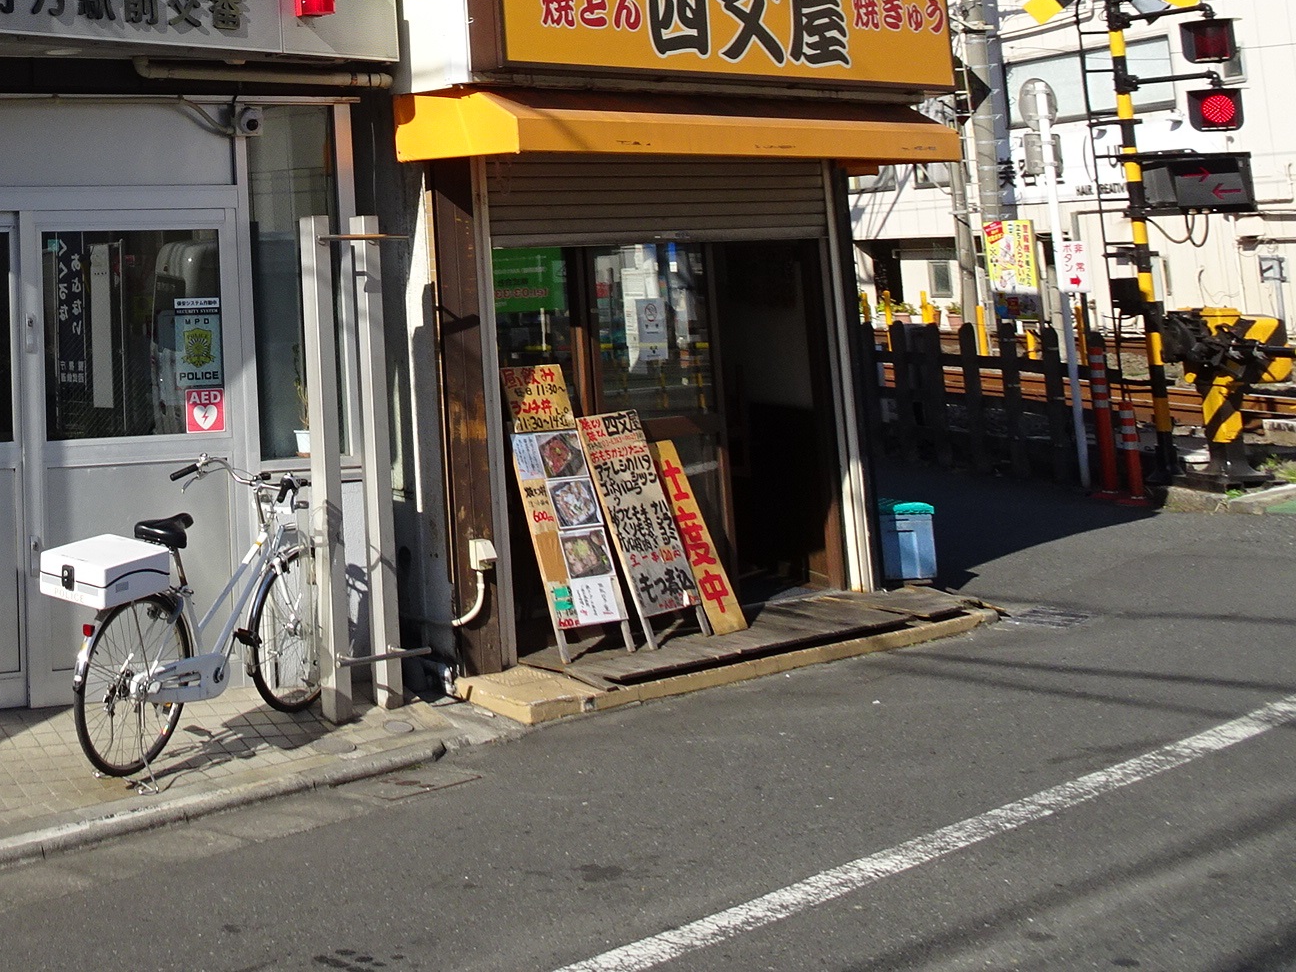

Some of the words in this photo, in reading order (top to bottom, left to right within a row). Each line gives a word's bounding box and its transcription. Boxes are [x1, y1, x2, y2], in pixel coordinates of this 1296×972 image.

[1062, 244, 1073, 272] ボタン
[1074, 244, 1085, 272] 非常
[179, 371, 219, 381] POLICE
[189, 391, 221, 404] AED
[602, 411, 642, 437] 四文屋
[54, 587, 85, 603] POLICE
